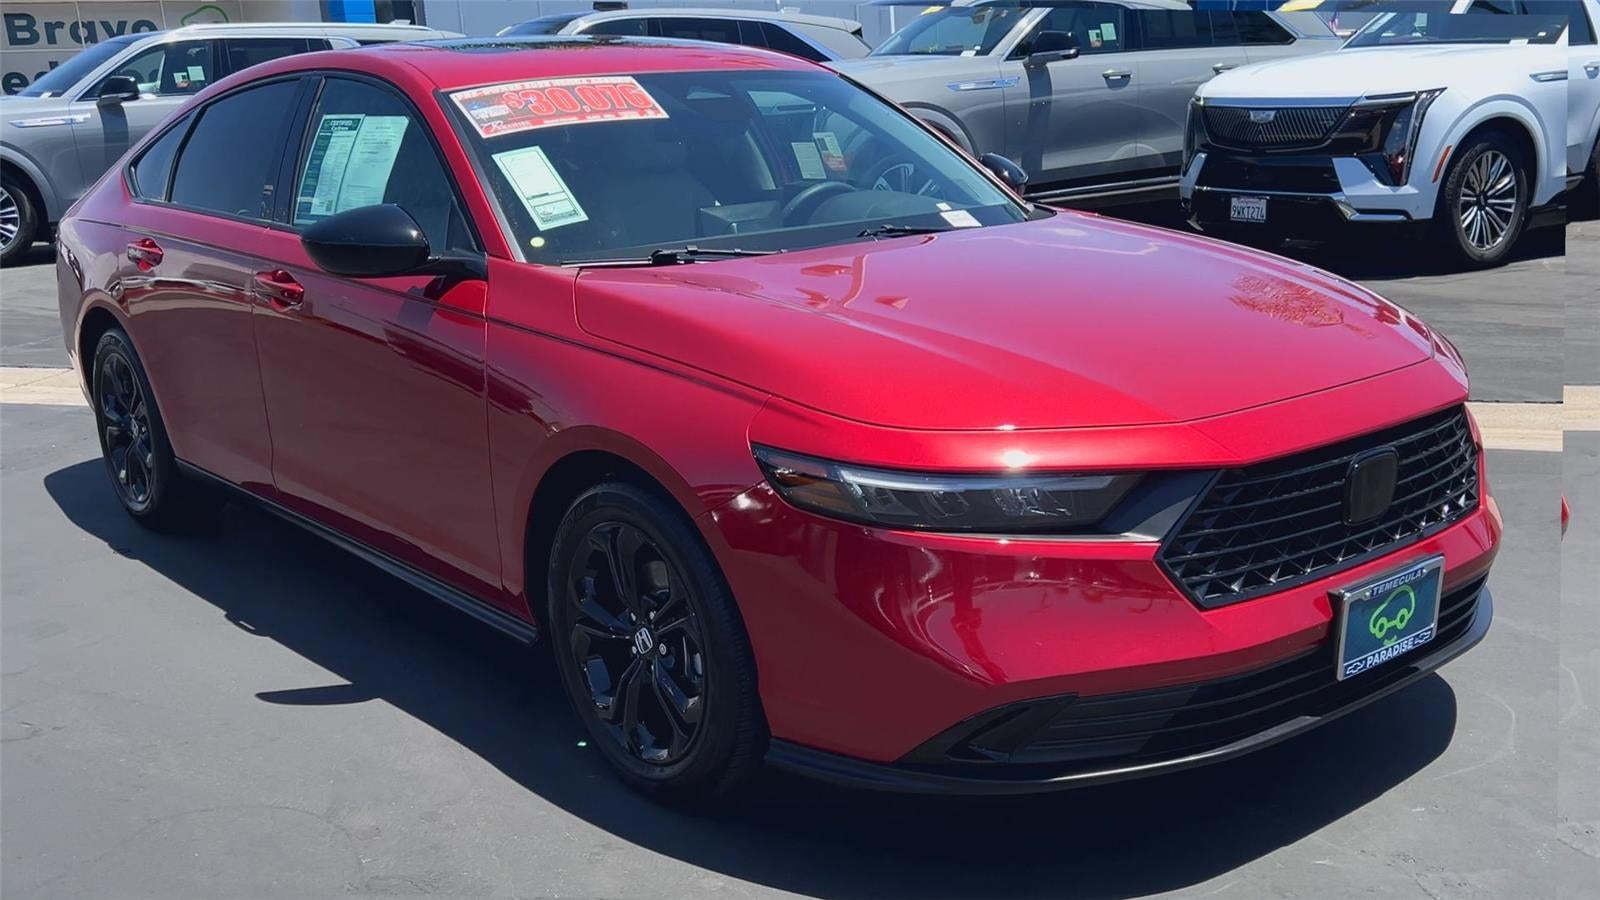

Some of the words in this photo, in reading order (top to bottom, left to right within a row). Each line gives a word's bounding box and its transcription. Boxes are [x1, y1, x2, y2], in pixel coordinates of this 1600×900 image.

[502, 83, 653, 116] $30,076
[1372, 569, 1422, 596] TEMECULA
[1366, 637, 1414, 668] PARADISE
